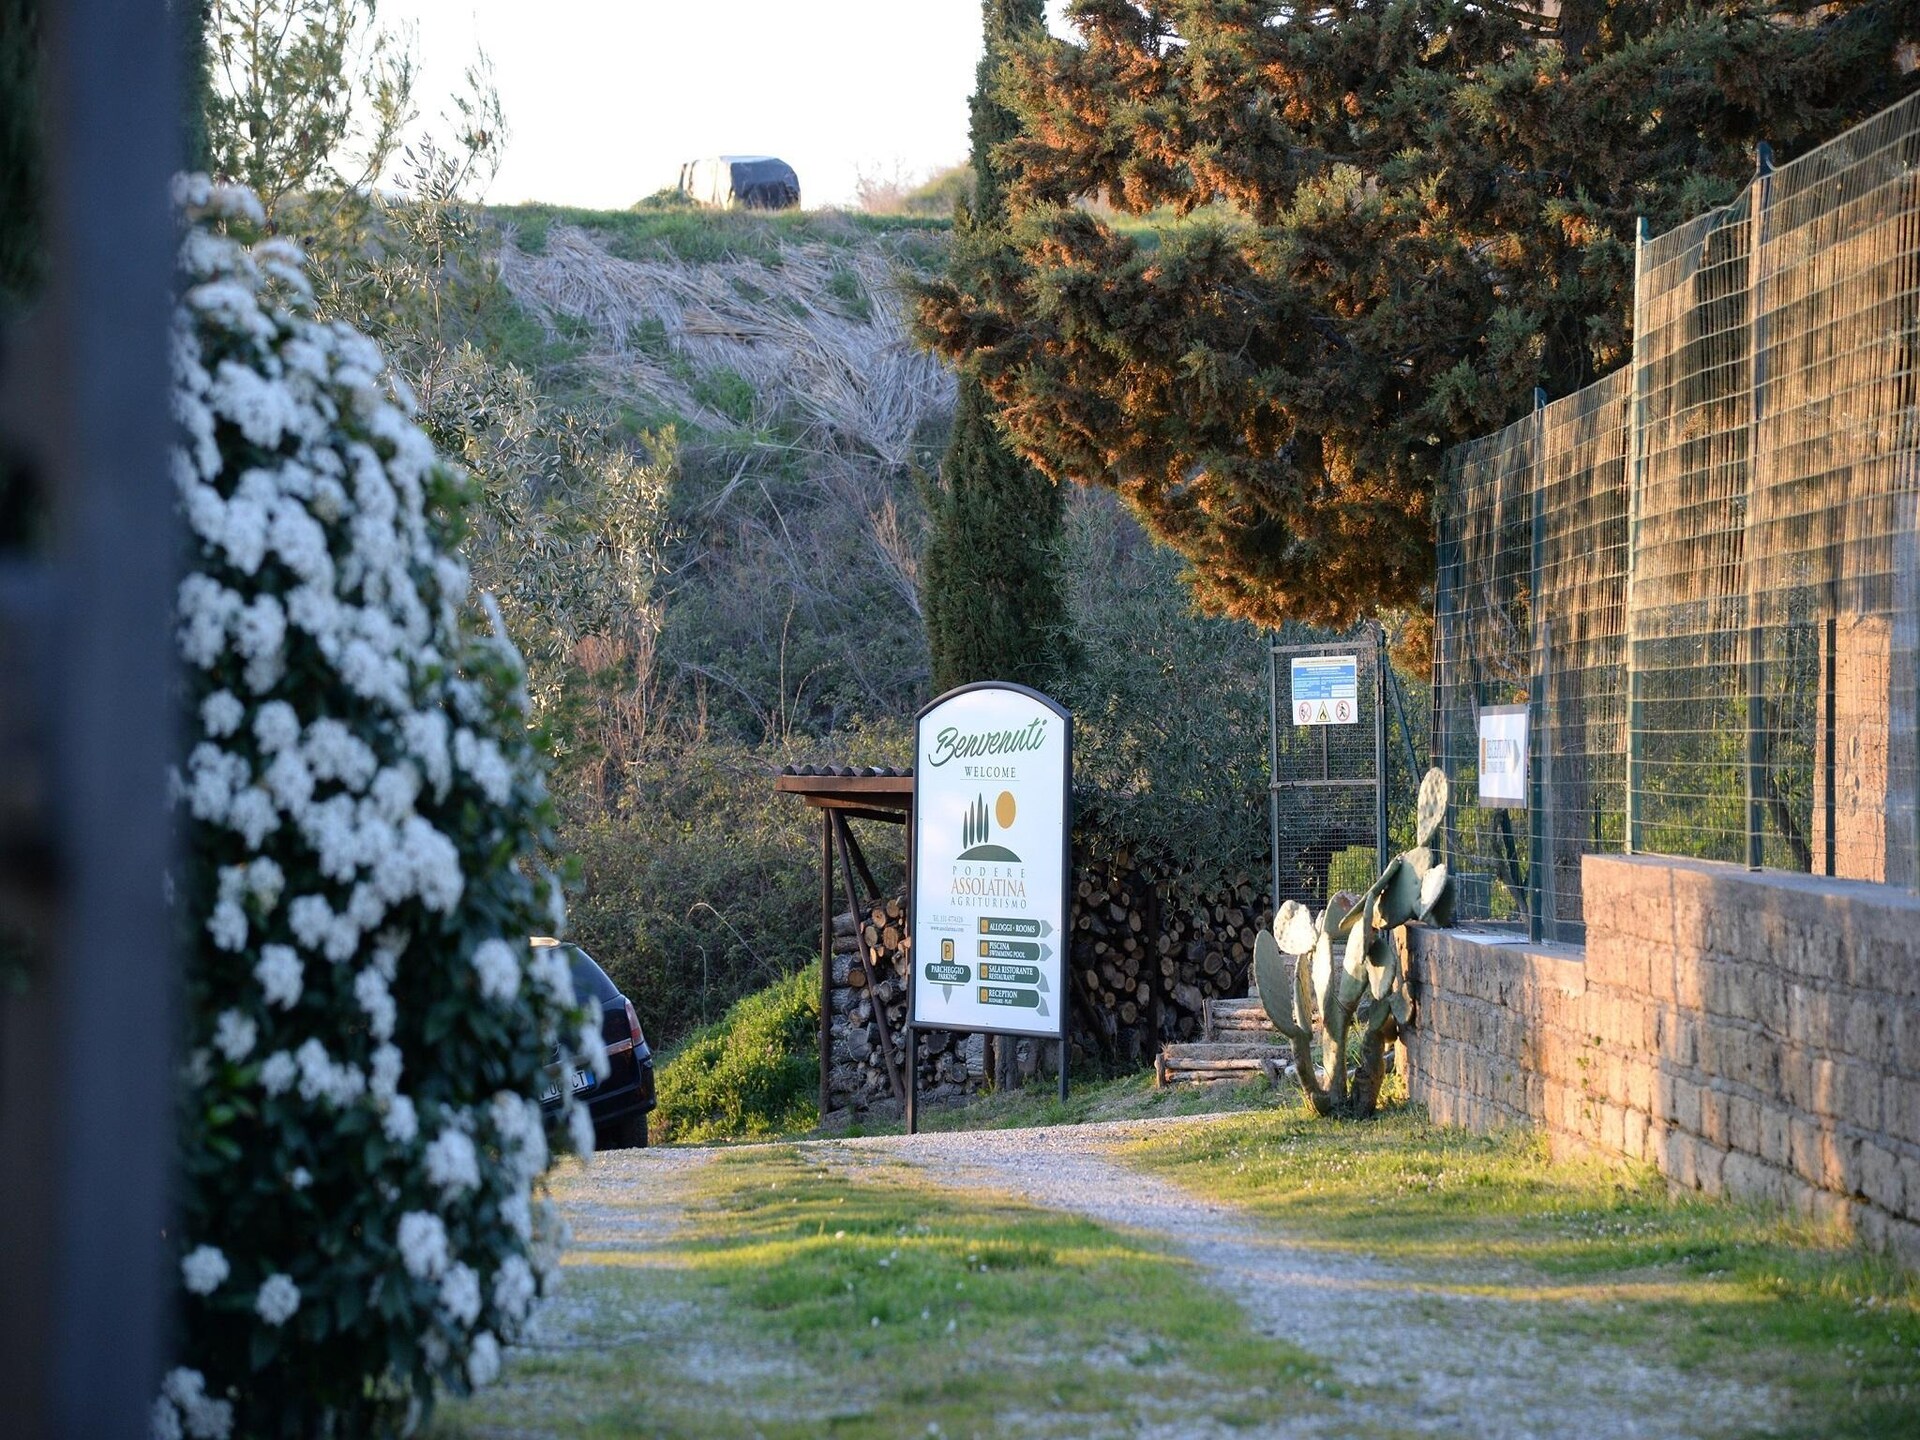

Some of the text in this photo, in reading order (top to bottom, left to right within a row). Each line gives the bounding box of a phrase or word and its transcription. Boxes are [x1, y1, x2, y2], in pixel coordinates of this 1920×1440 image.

[928, 717, 1048, 767] Benvenuti
[964, 766, 1016, 778] WELCOME
[952, 866, 1025, 878] PODERE
[951, 877, 1026, 897] ASSOLATINA
[950, 897, 1027, 909] AGRITURISMO
[989, 923, 1035, 933] ALLOGGI ROOMS
[989, 942, 1010, 950] PISCINA
[931, 965, 964, 975] PARCHEGGIO
[989, 965, 1033, 975] SALA RISTORANTE
[989, 973, 1015, 981] RESTAURANT
[989, 989, 1017, 998] RECEPTION
